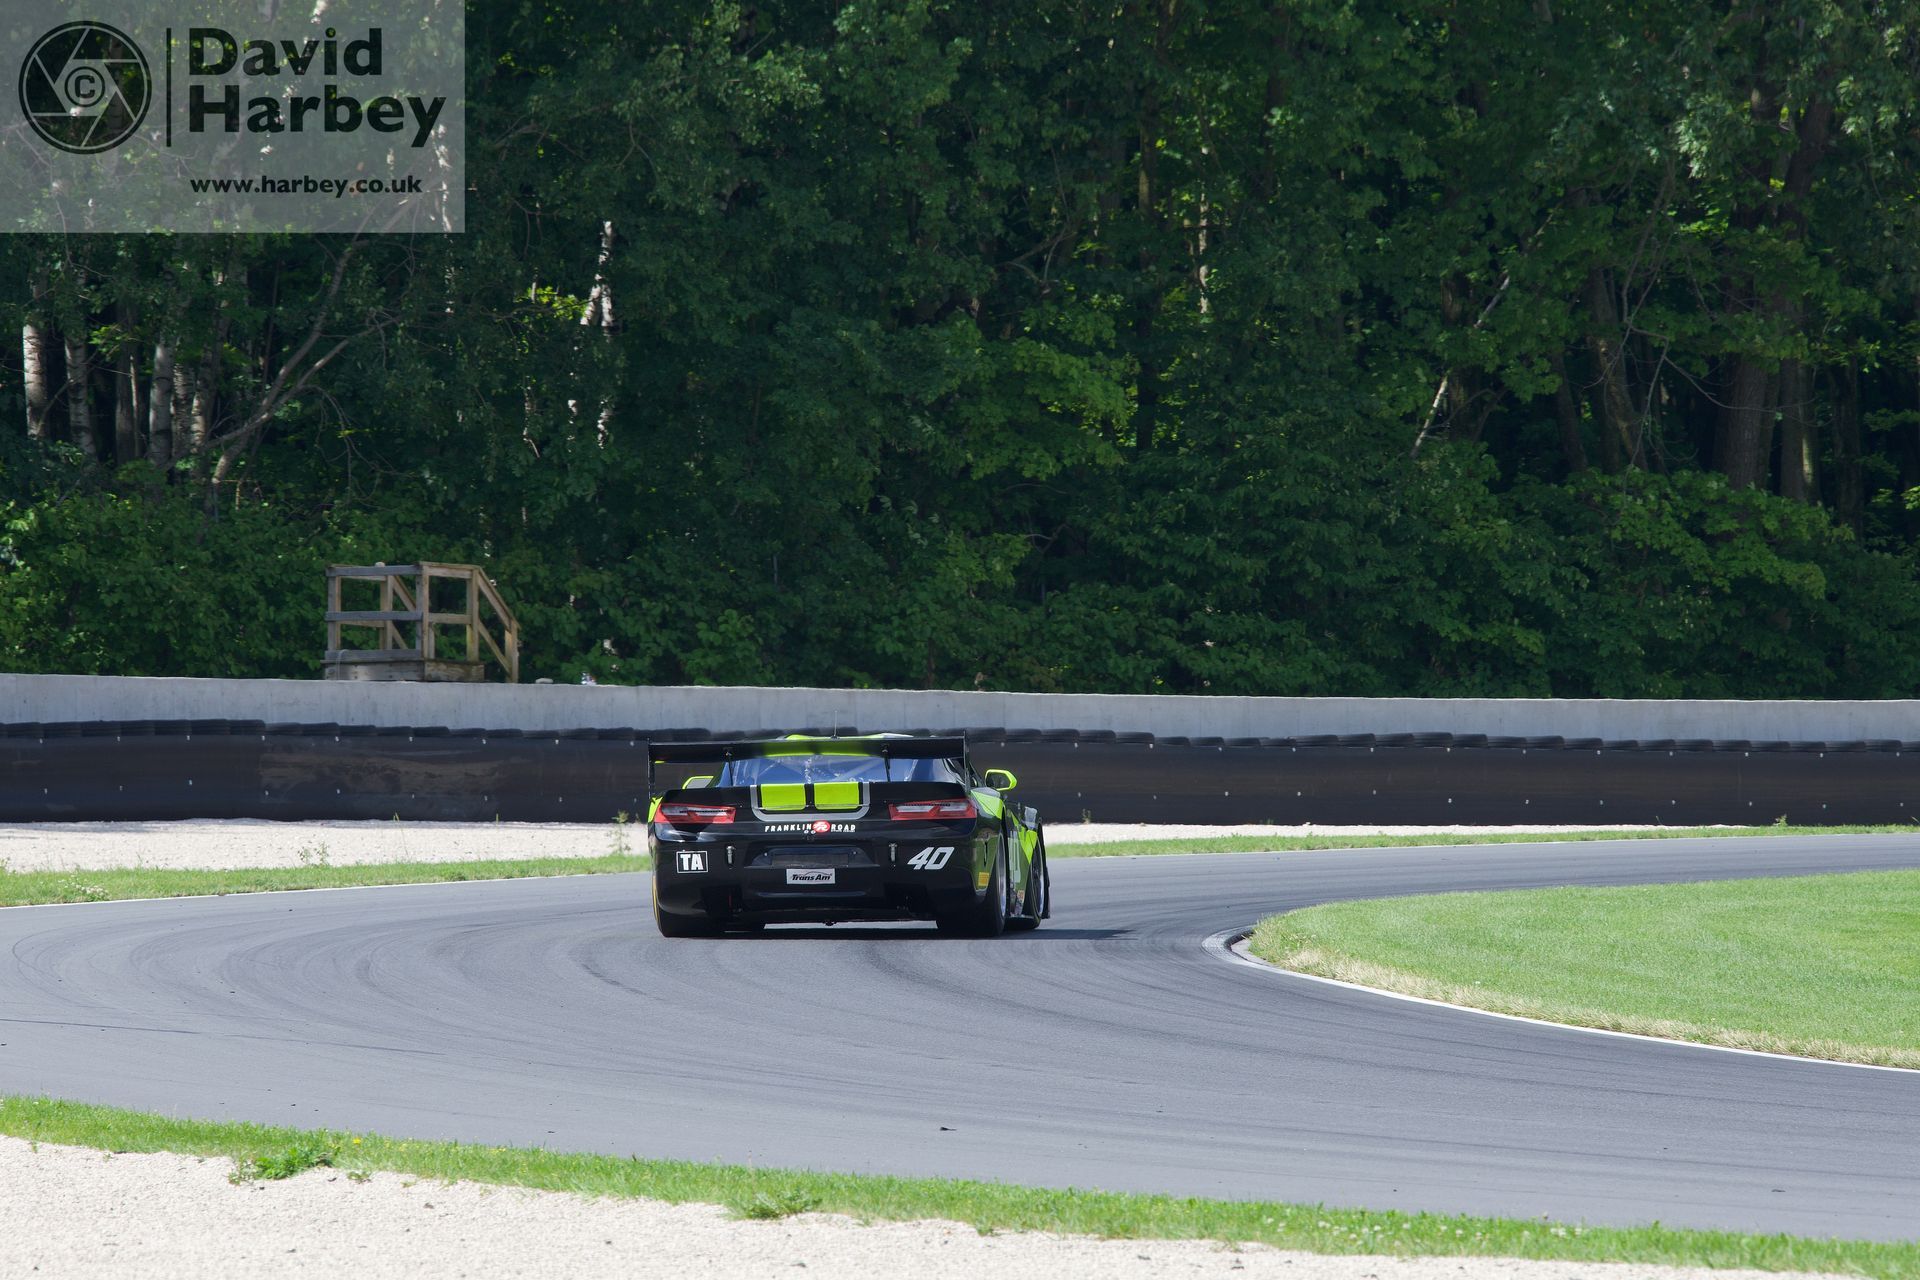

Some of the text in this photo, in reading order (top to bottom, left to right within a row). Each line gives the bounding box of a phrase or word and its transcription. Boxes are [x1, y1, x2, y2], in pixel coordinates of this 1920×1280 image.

[765, 823, 812, 832] FRANKLIN
[680, 853, 704, 870] TA
[907, 846, 955, 870] 40
